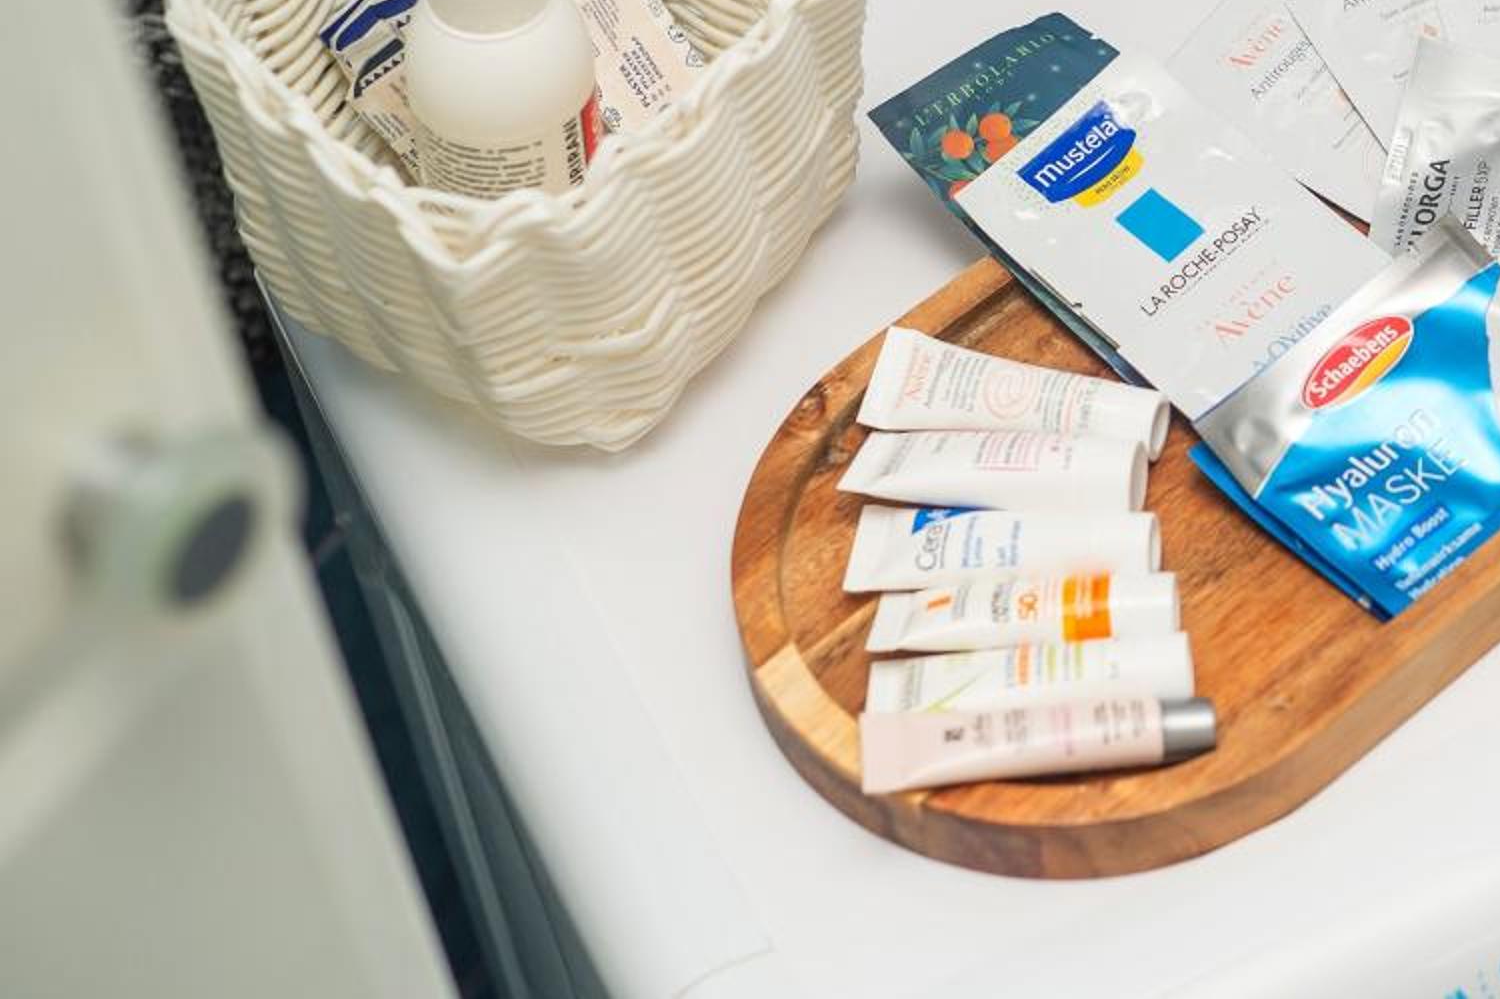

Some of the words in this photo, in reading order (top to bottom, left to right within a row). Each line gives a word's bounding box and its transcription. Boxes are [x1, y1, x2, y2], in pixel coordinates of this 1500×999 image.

[1140, 295, 1167, 317] LA
[1160, 208, 1262, 300] ROCHE-POSAY
[1310, 323, 1399, 400] Schaebens
[1301, 408, 1441, 521] Hyaluron
[1333, 445, 1467, 552] MASKE
